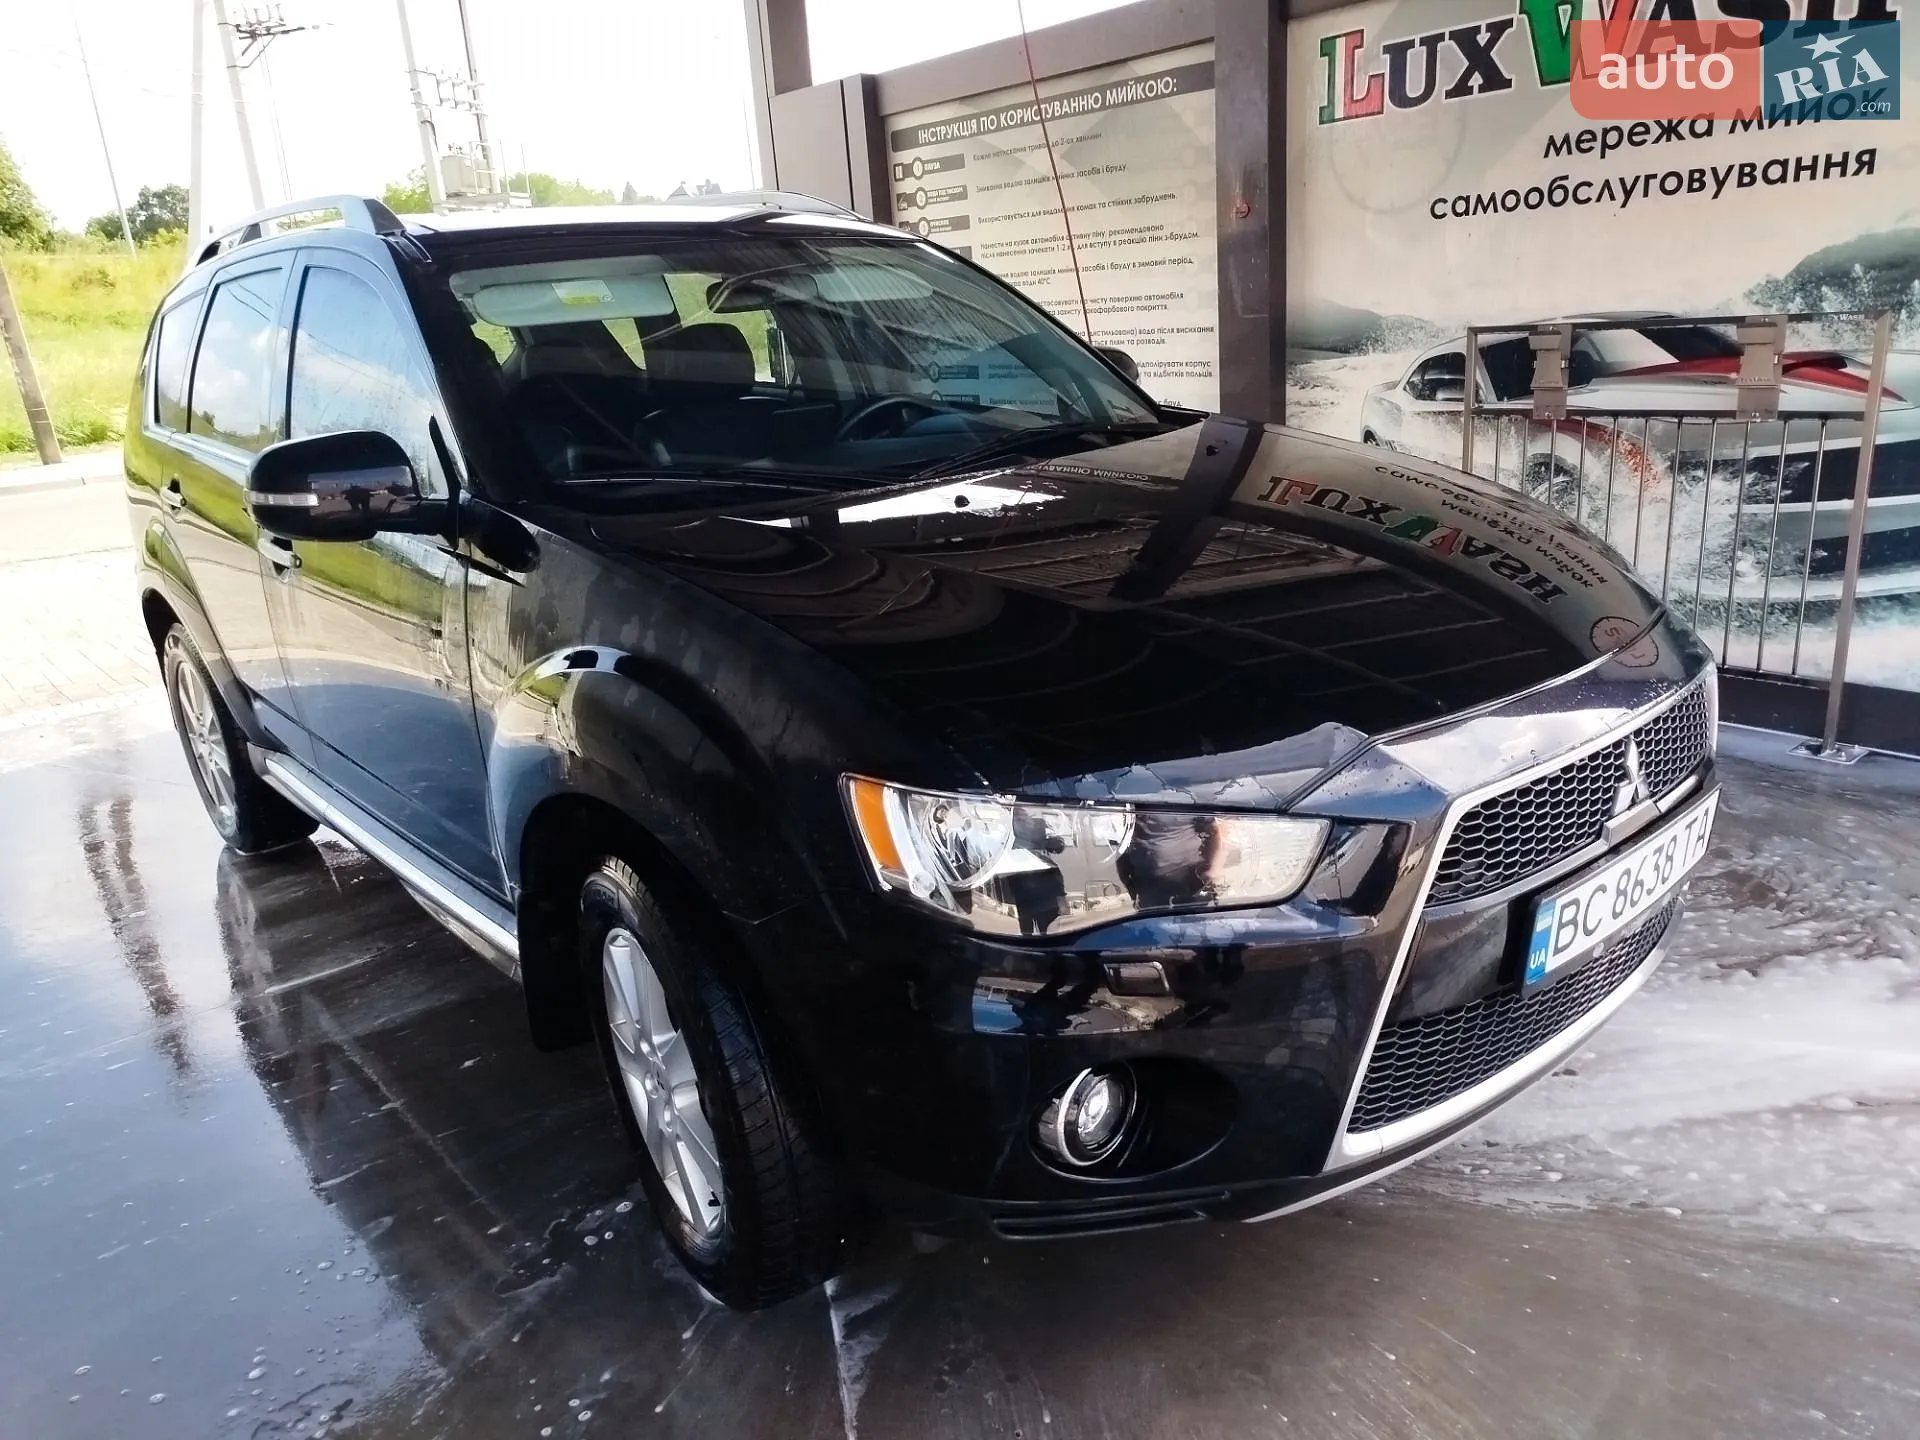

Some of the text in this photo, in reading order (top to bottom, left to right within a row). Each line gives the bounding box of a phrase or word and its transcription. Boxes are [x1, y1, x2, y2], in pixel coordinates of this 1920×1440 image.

[918, 76, 1177, 144] ІНСТРУКЦІЯ ПО КОРИСТУВАННЮ МИЙКОЮ:
[1543, 117, 1714, 160] мережа
[1430, 146, 1878, 220] самообслуговування
[1127, 338, 1135, 346] та
[1185, 360, 1211, 369] корпус
[1552, 883, 1608, 956] BC
[1611, 833, 1678, 921] 8638
[1530, 947, 1546, 969] UA
